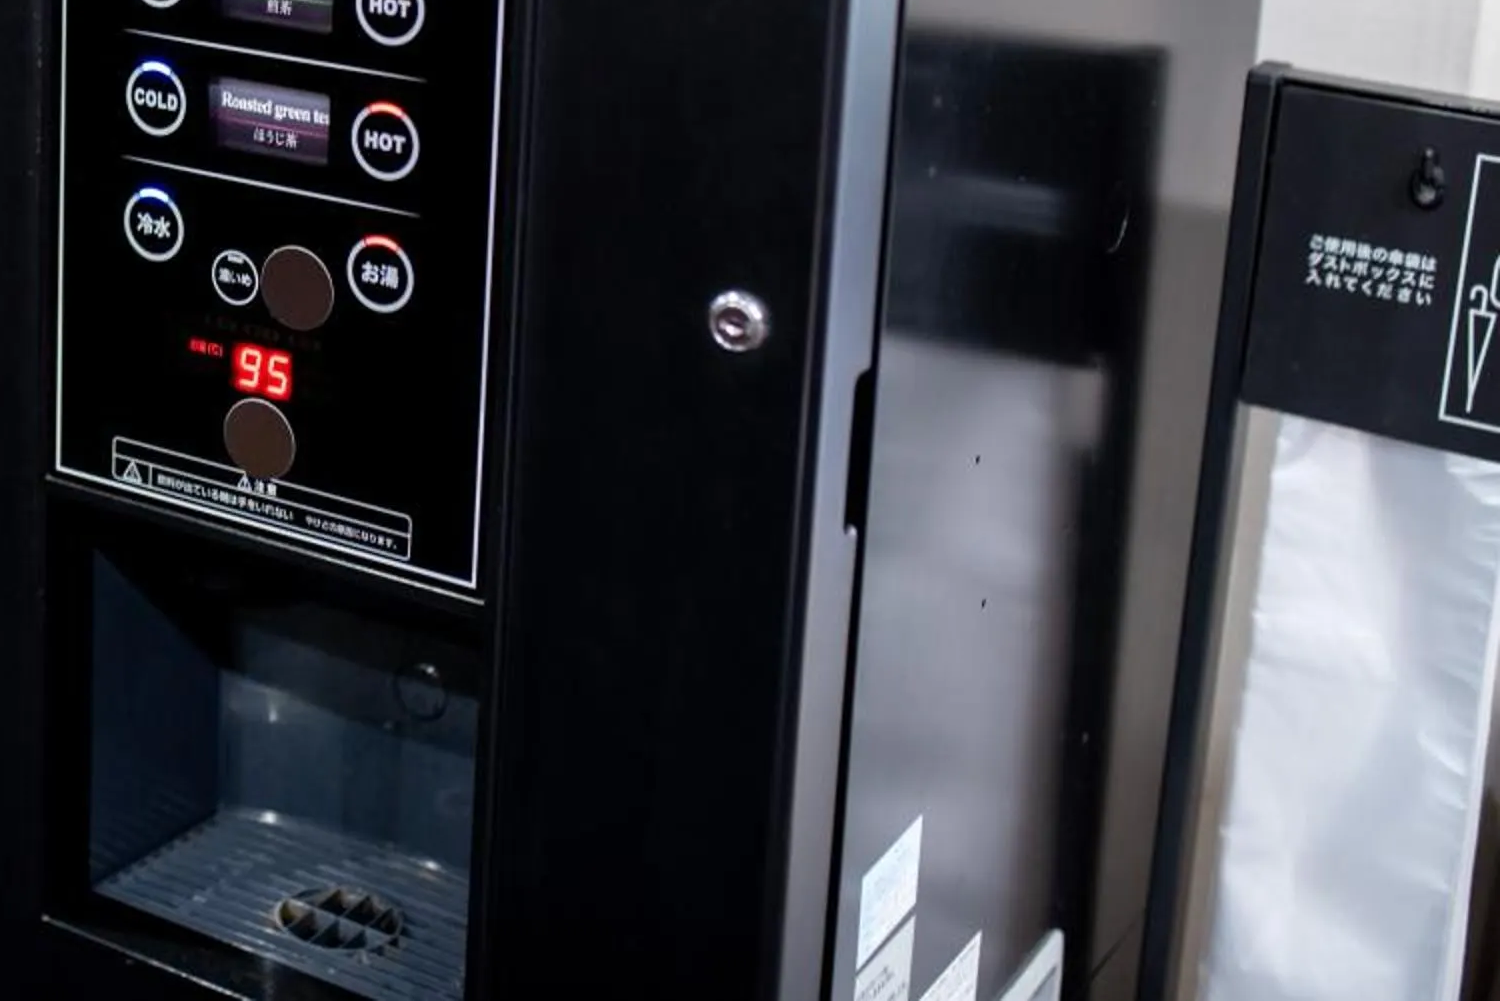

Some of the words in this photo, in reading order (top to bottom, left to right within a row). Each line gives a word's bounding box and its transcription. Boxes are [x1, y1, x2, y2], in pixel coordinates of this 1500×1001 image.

[134, 88, 178, 111] COLD
[221, 91, 272, 116] Roasted
[274, 102, 311, 121] green
[253, 126, 298, 149] ほうじ茶
[364, 129, 406, 153] HOT
[136, 212, 171, 238] 冷水
[361, 261, 399, 290] お湯
[1307, 251, 1436, 290] ダストボックスに
[1305, 268, 1433, 306] 入れてください
[238, 347, 290, 396] 95
